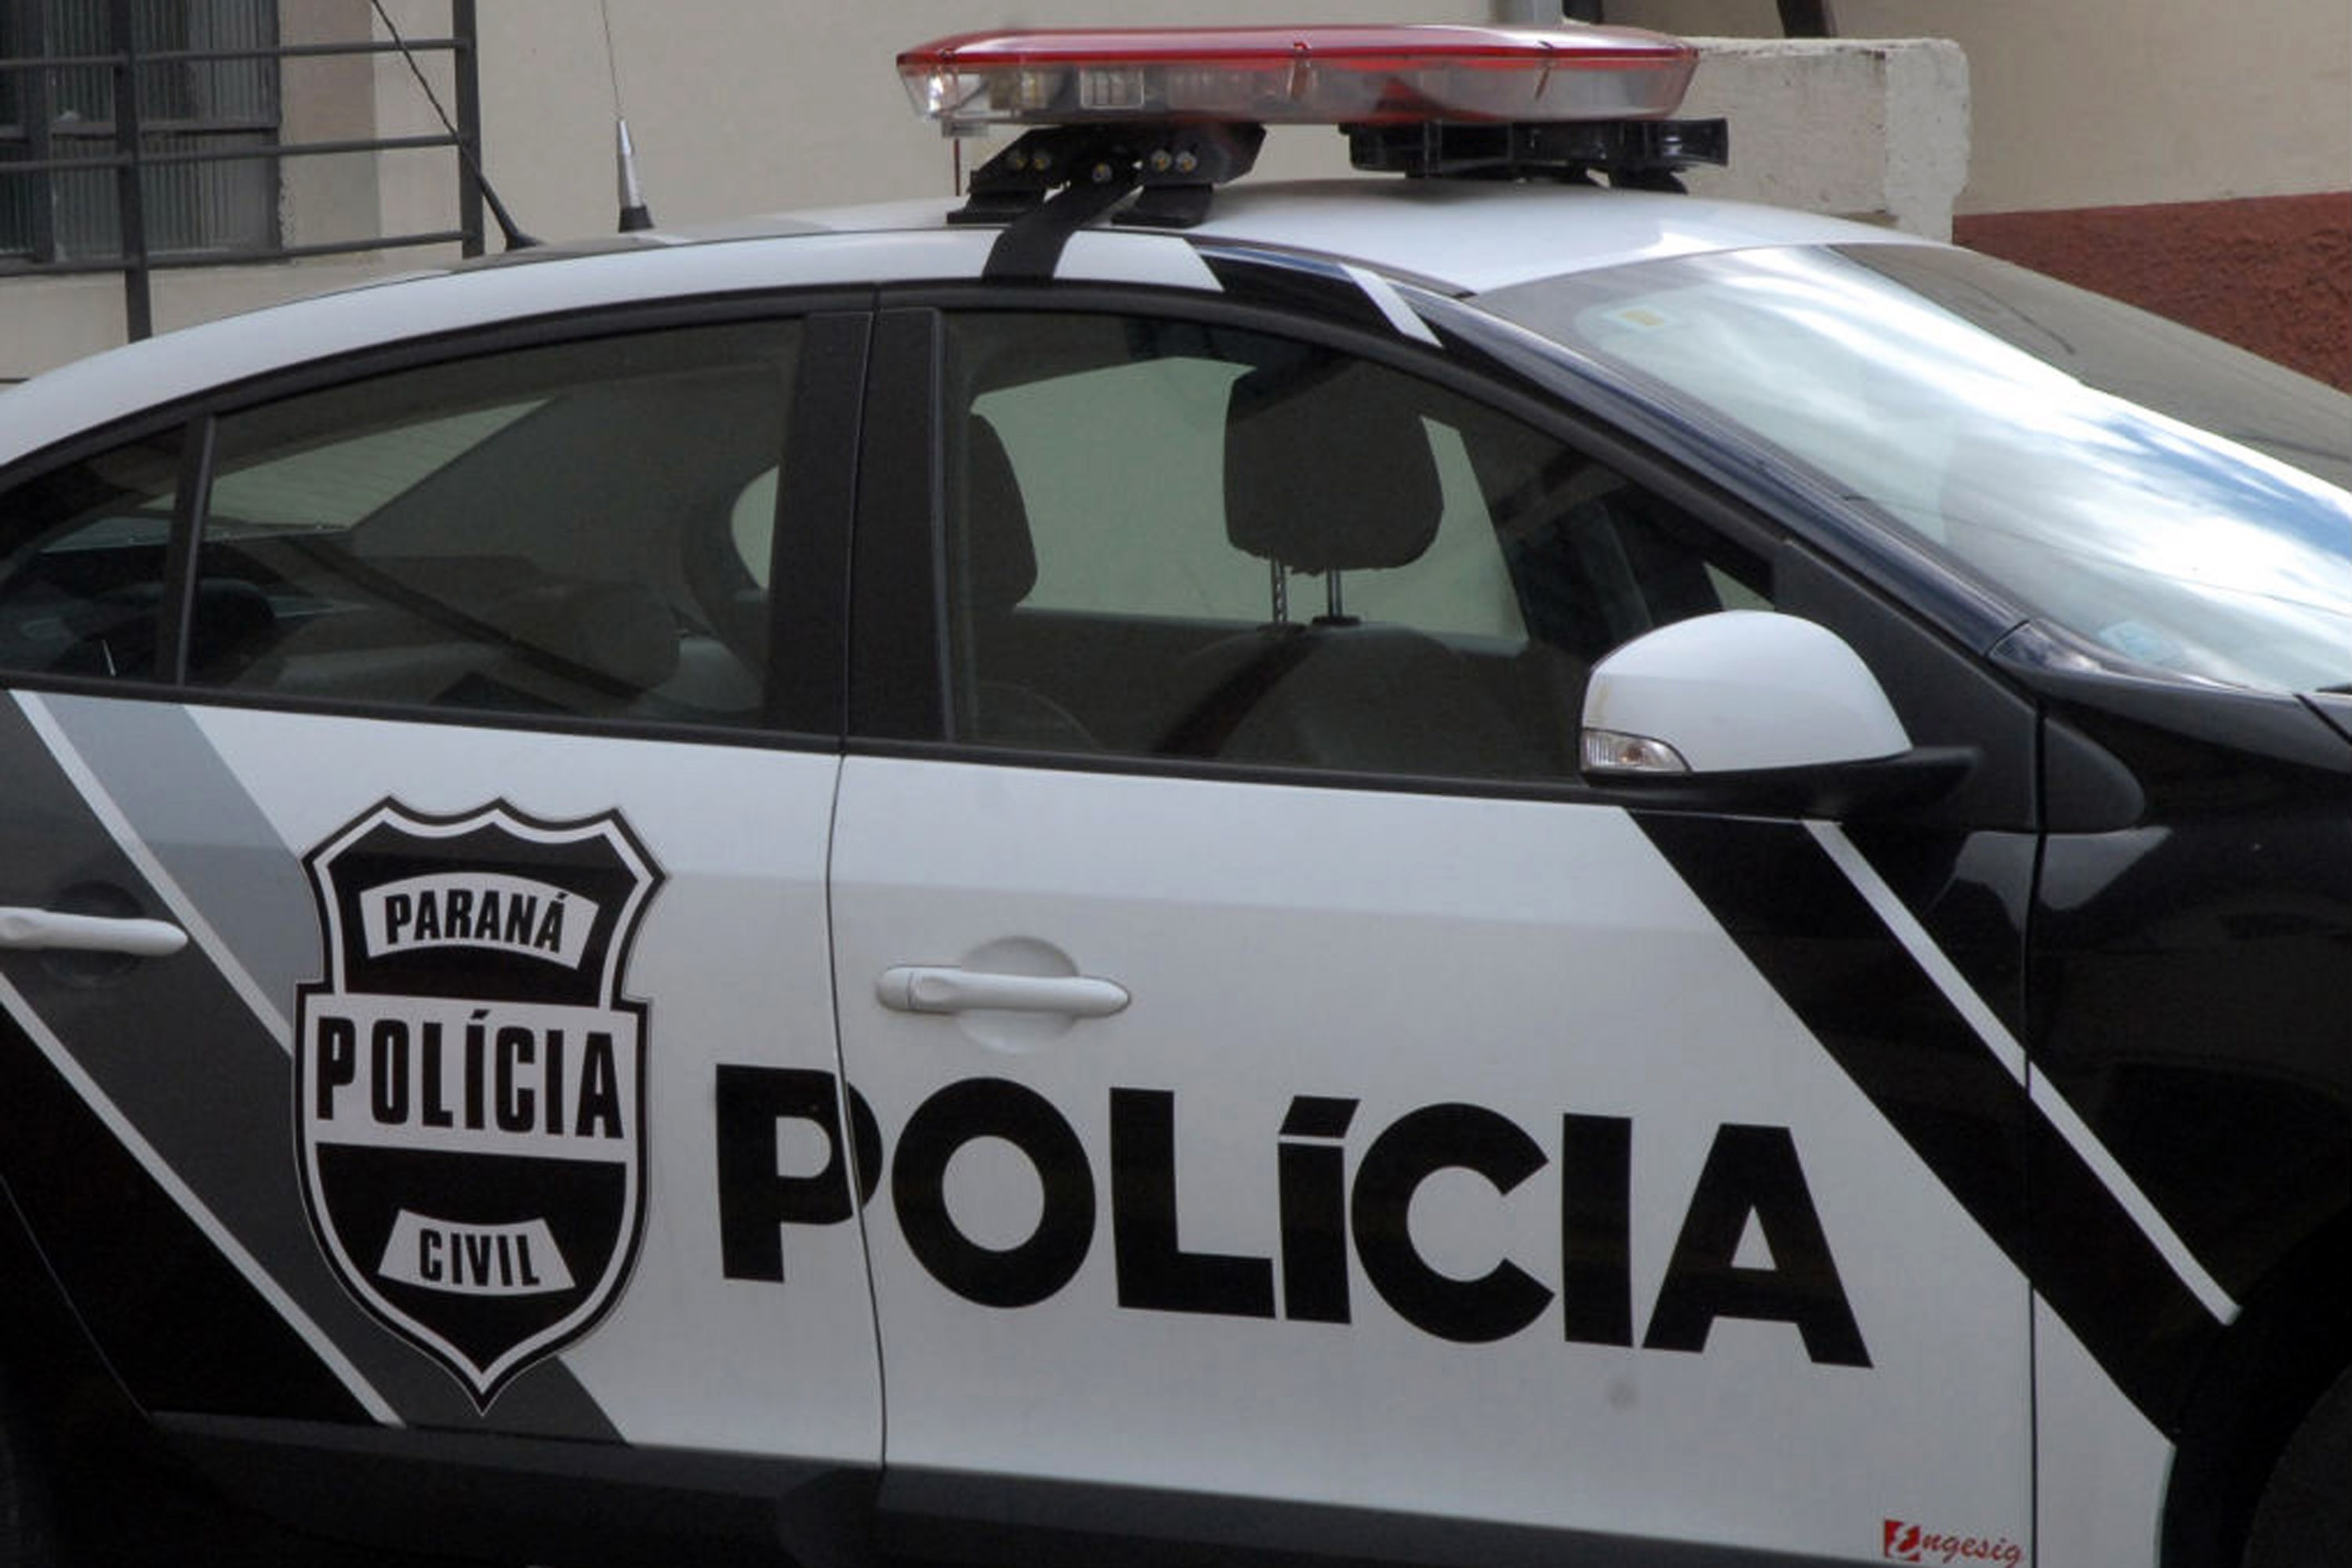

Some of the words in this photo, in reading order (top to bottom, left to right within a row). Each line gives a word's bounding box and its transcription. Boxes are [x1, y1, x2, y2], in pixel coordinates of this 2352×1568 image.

[385, 888, 568, 953] PARANÁ
[317, 1009, 624, 1140] POLÍCIA
[419, 1228, 541, 1287] CIVIL
[716, 1064, 1874, 1370] POLÍCIA
